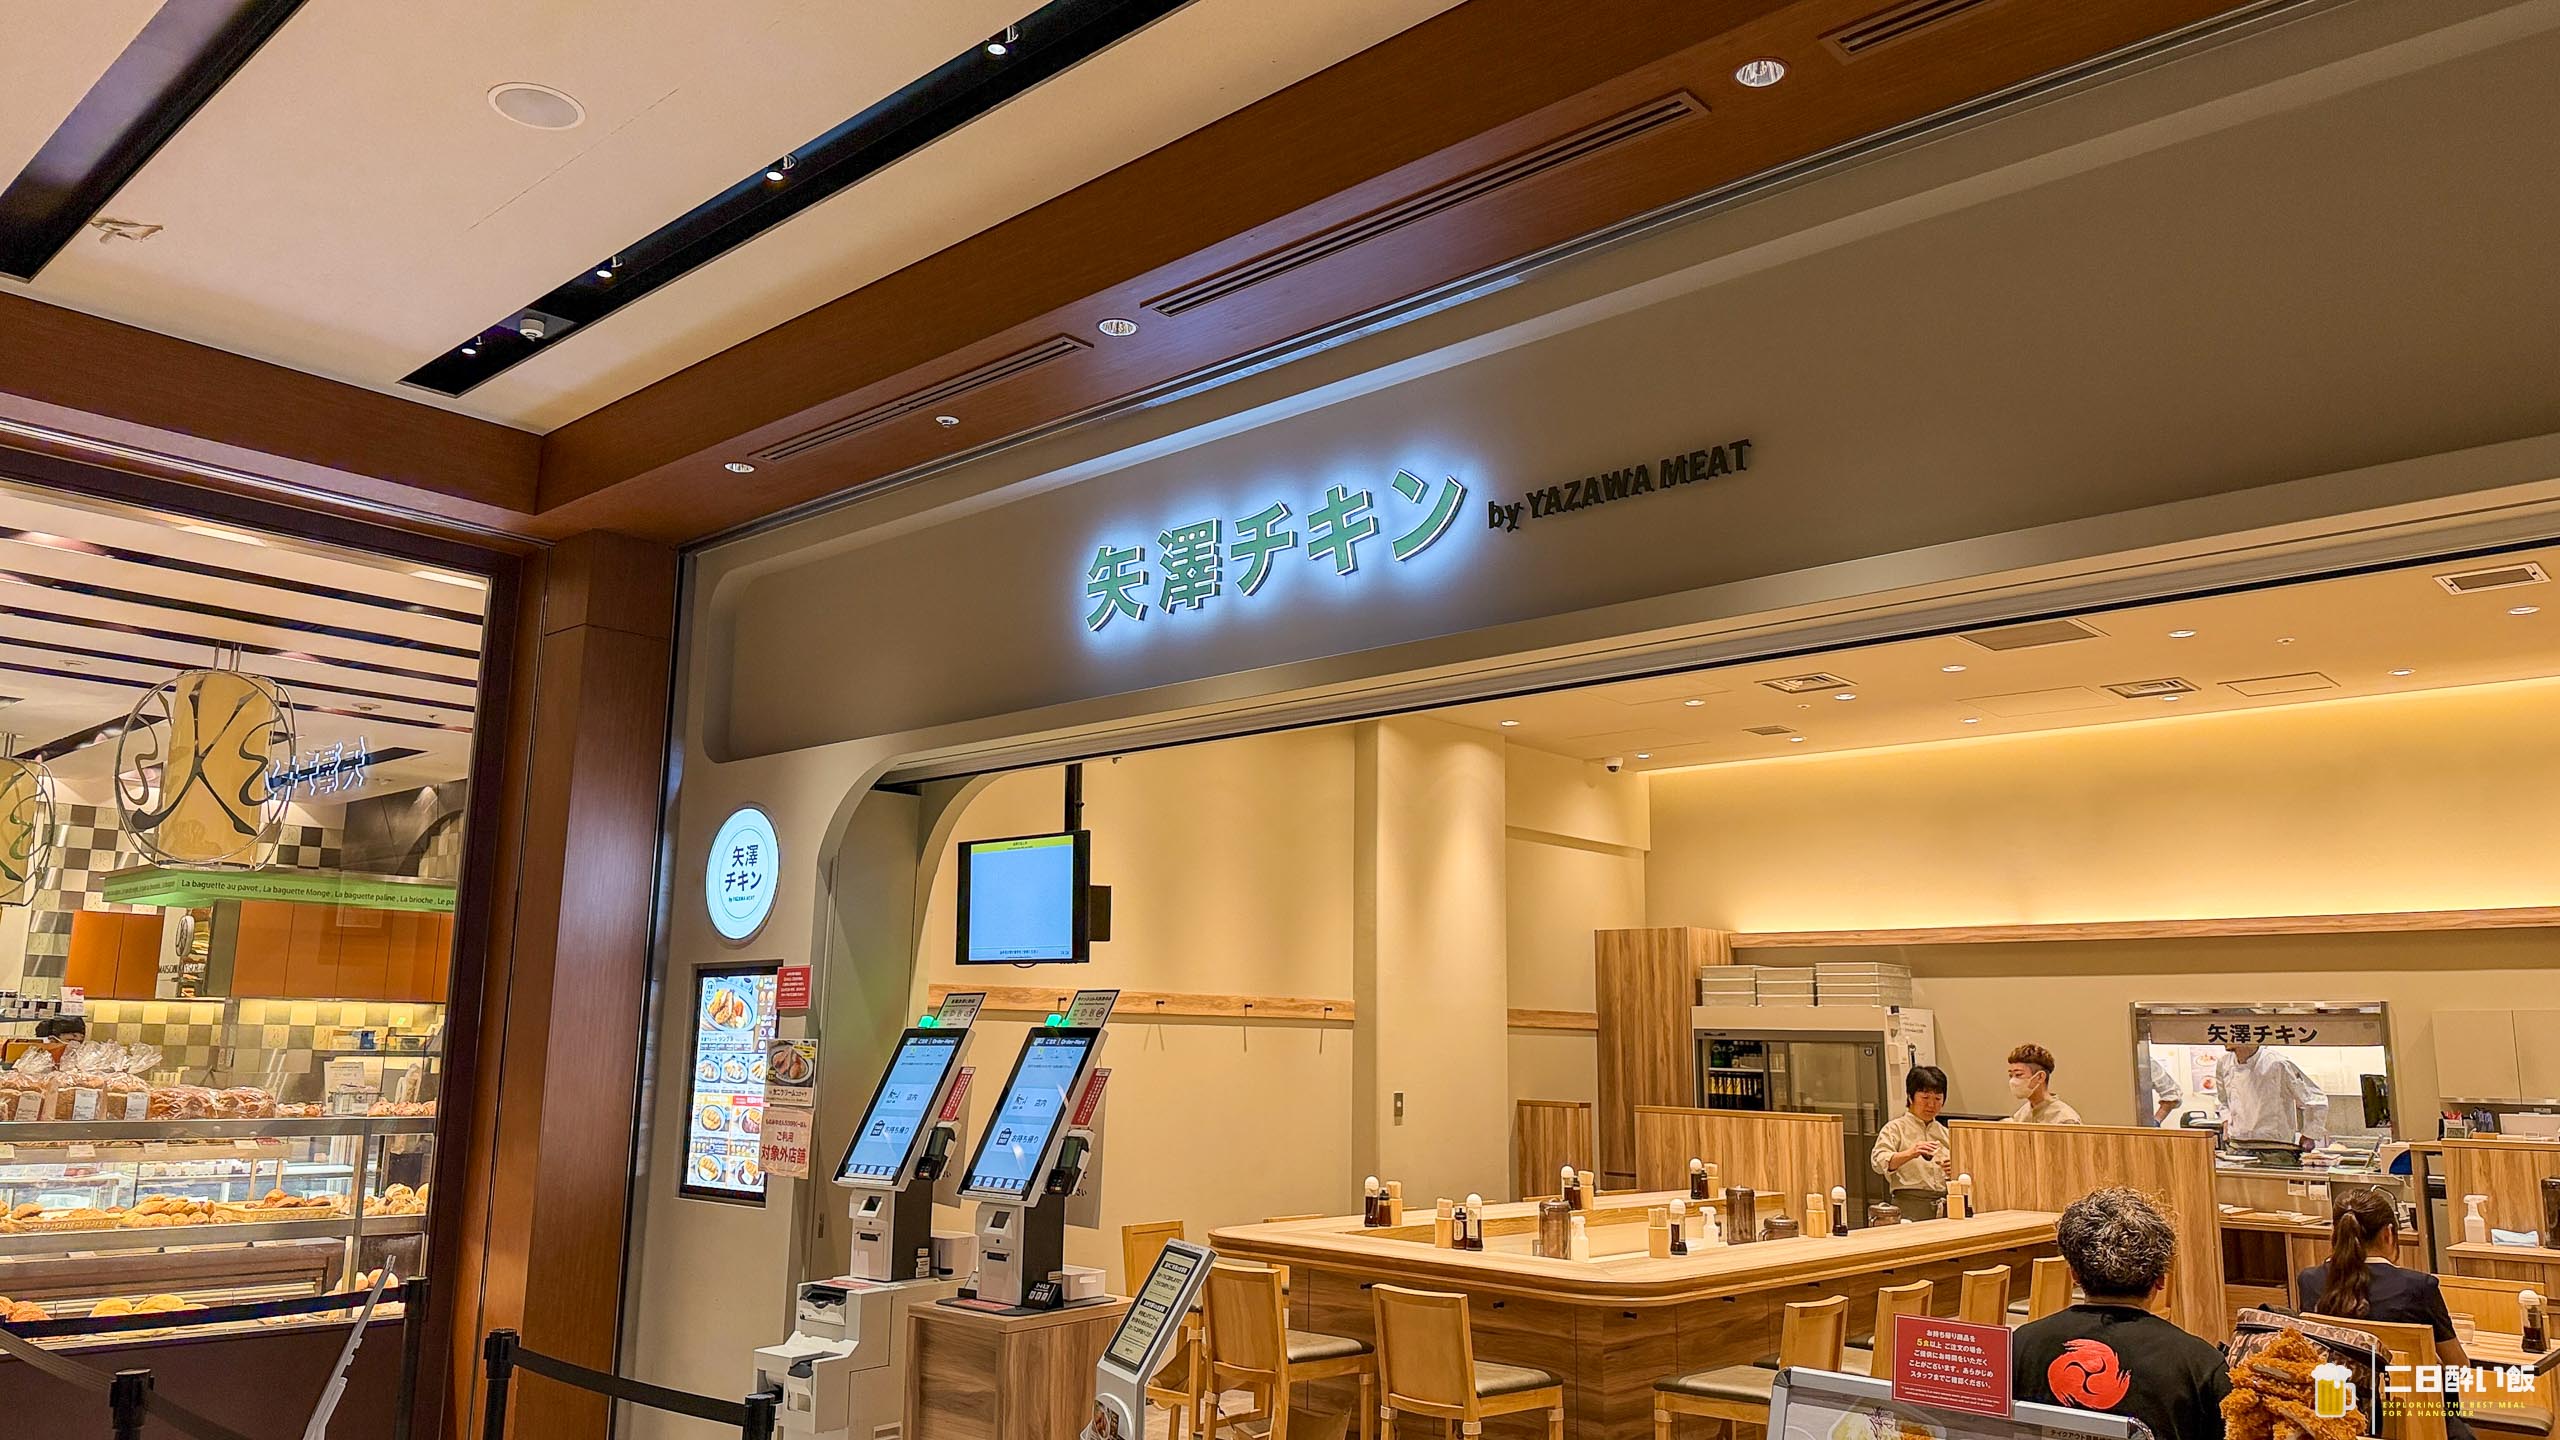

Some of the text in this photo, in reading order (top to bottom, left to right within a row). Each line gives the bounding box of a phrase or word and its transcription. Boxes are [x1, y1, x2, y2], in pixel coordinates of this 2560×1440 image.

[1488, 439, 1751, 532] by YAZAWA MEAT
[1085, 468, 1467, 632] 矢澤チキン
[732, 844, 758, 868] 矢澤
[181, 879, 191, 887] La
[192, 880, 226, 892] baguette
[263, 885, 272, 893] La
[273, 886, 305, 896] baguette
[344, 891, 375, 902] baguette
[725, 870, 762, 892] チキン
[2207, 1023, 2318, 1045] 矢澤チキン
[1011, 1135, 1039, 1144] お持ち帰り
[761, 1144, 806, 1165] 対象外店舗
[1916, 1338, 1942, 1350] 5食以上
[1926, 1329, 1976, 1343] お持ち帰り商品を
[1913, 1349, 1988, 1366] ご提供にお時間をいただく
